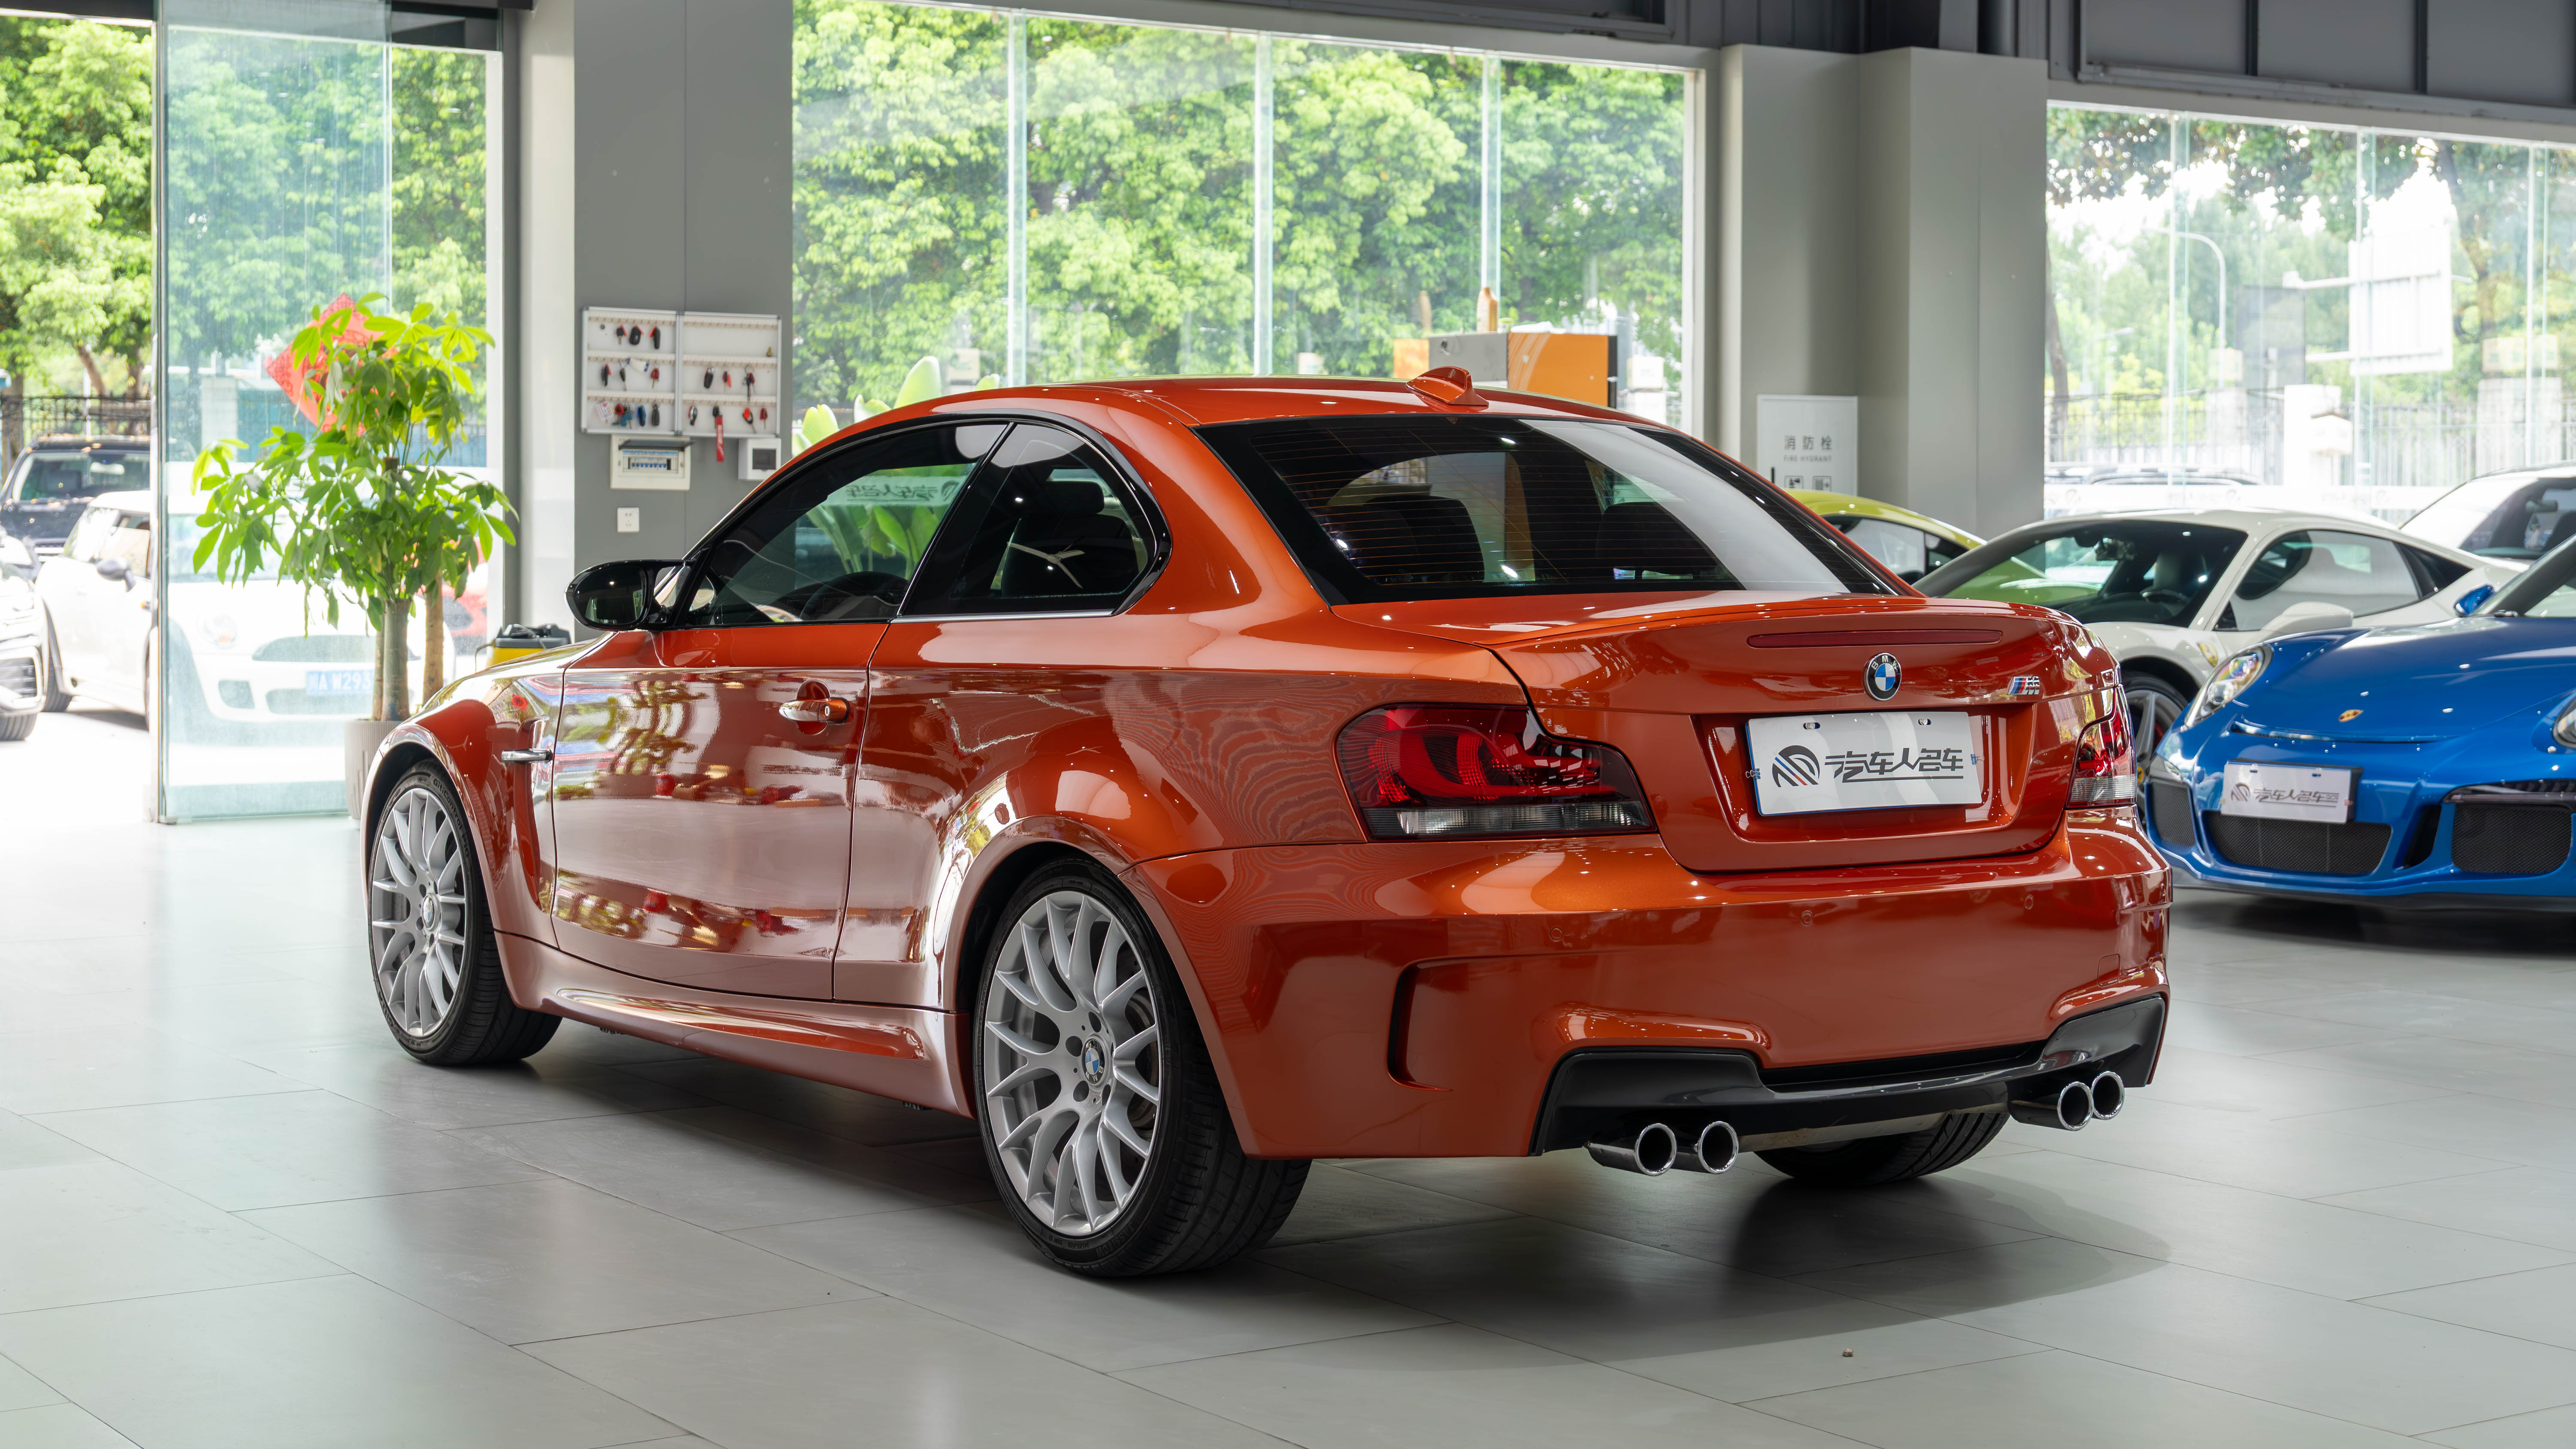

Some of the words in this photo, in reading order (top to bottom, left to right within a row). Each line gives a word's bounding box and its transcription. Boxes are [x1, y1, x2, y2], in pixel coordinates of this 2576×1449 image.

[1784, 435, 1832, 450] 消防栓
[1871, 655, 1899, 670] BMW
[1825, 747, 1964, 783] 汽车人名车
[433, 778, 463, 830] GitiControl
[2254, 788, 2325, 806] 汽车人名车
